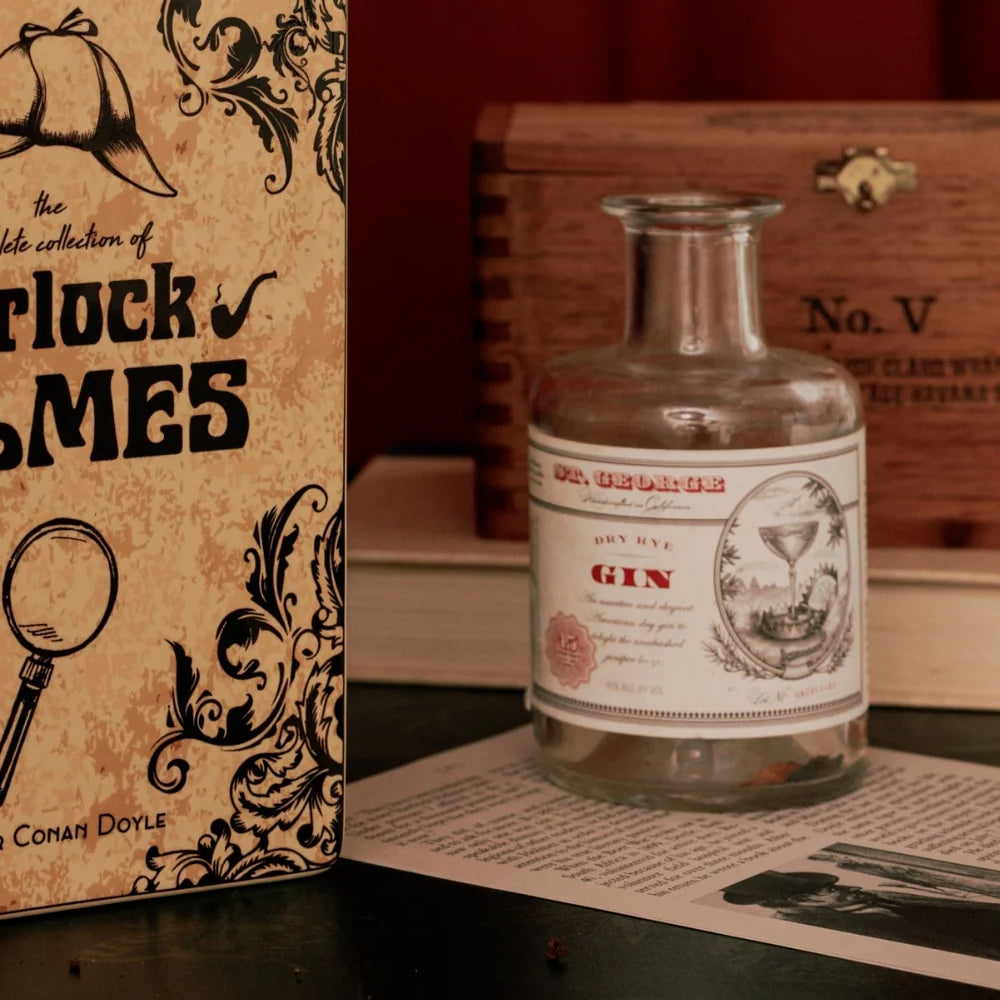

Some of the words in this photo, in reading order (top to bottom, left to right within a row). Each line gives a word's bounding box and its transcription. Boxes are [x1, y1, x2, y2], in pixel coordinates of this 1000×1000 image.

[33, 190, 68, 217] the
[35, 223, 124, 256] collection
[130, 221, 154, 260] of
[803, 295, 884, 334] No.
[895, 295, 938, 334] V
[553, 462, 590, 486] ST.
[594, 470, 726, 494] GEORGE
[594, 535, 627, 545] DRY
[636, 535, 674, 552] RYE
[591, 564, 675, 589] GIN
